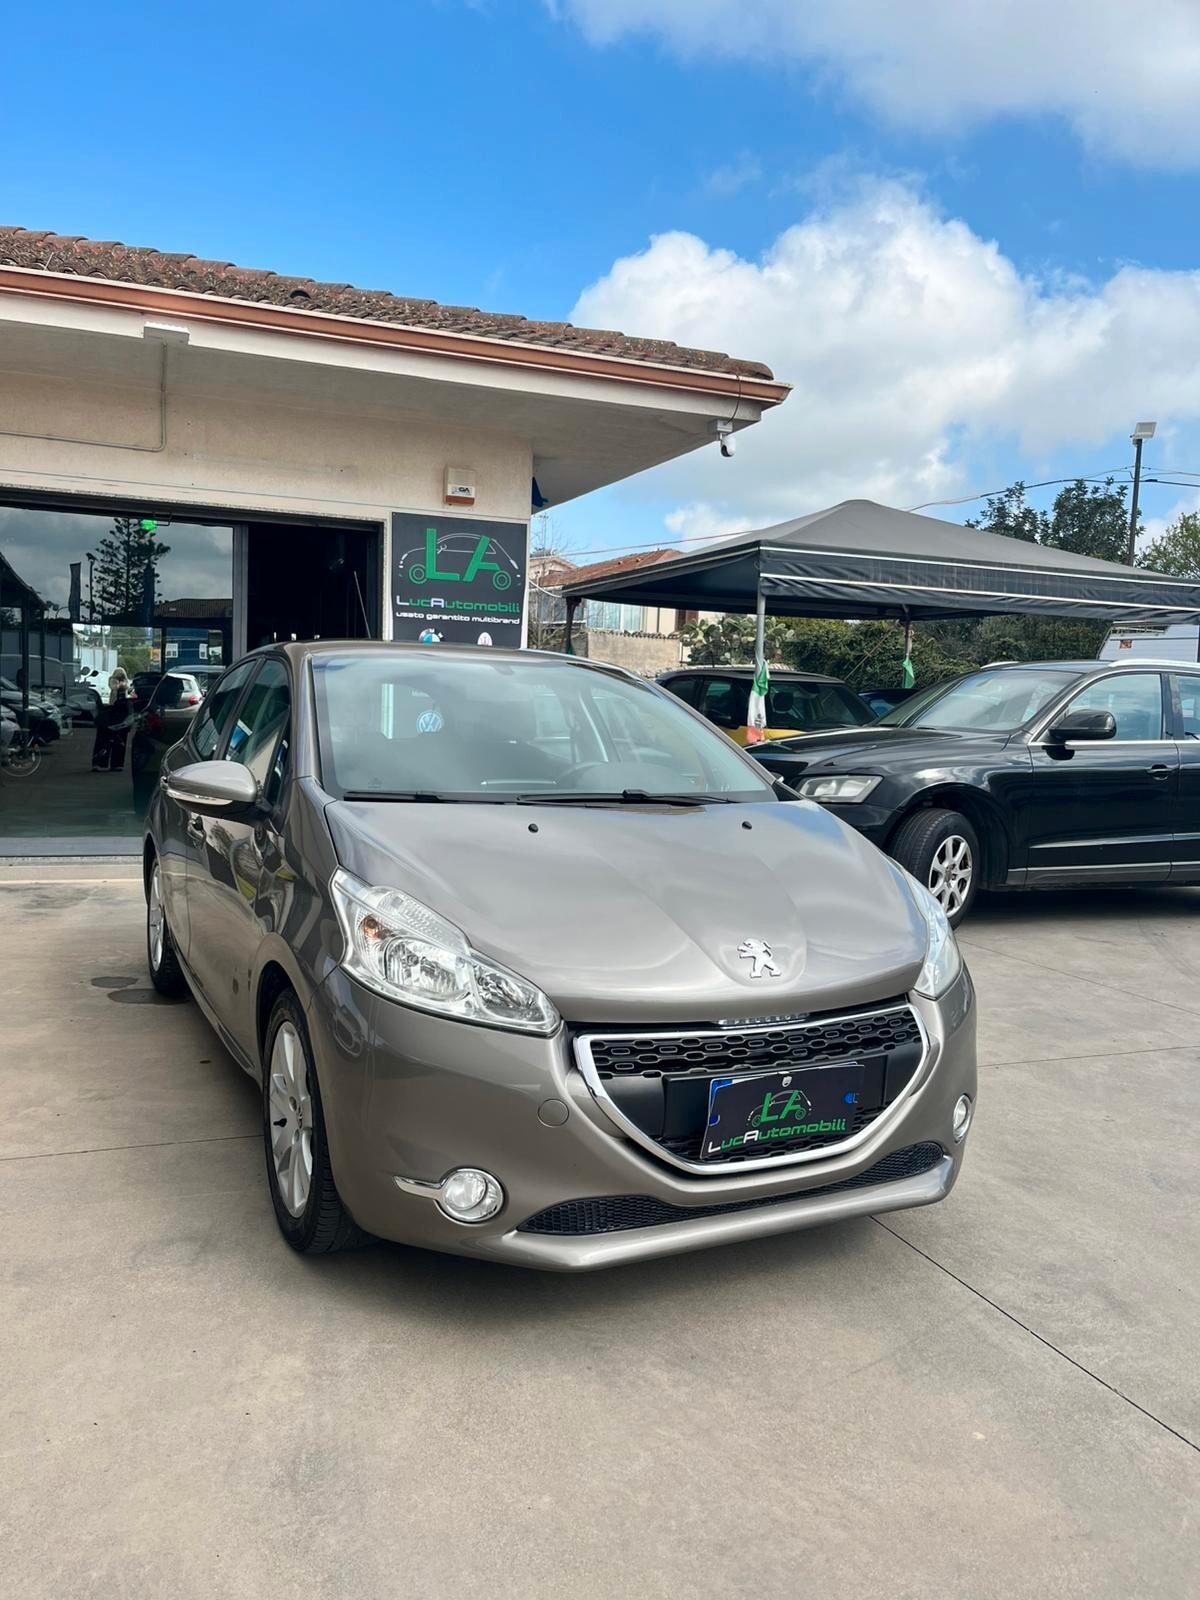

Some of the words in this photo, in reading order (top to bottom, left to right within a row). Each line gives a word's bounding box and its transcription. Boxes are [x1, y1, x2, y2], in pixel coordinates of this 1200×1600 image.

[396, 595, 520, 613] LucAutomobili
[396, 611, 425, 619] usato
[426, 612, 470, 622] garantito
[471, 615, 520, 625] multibrand
[708, 1118, 846, 1153] LucAutomobili
